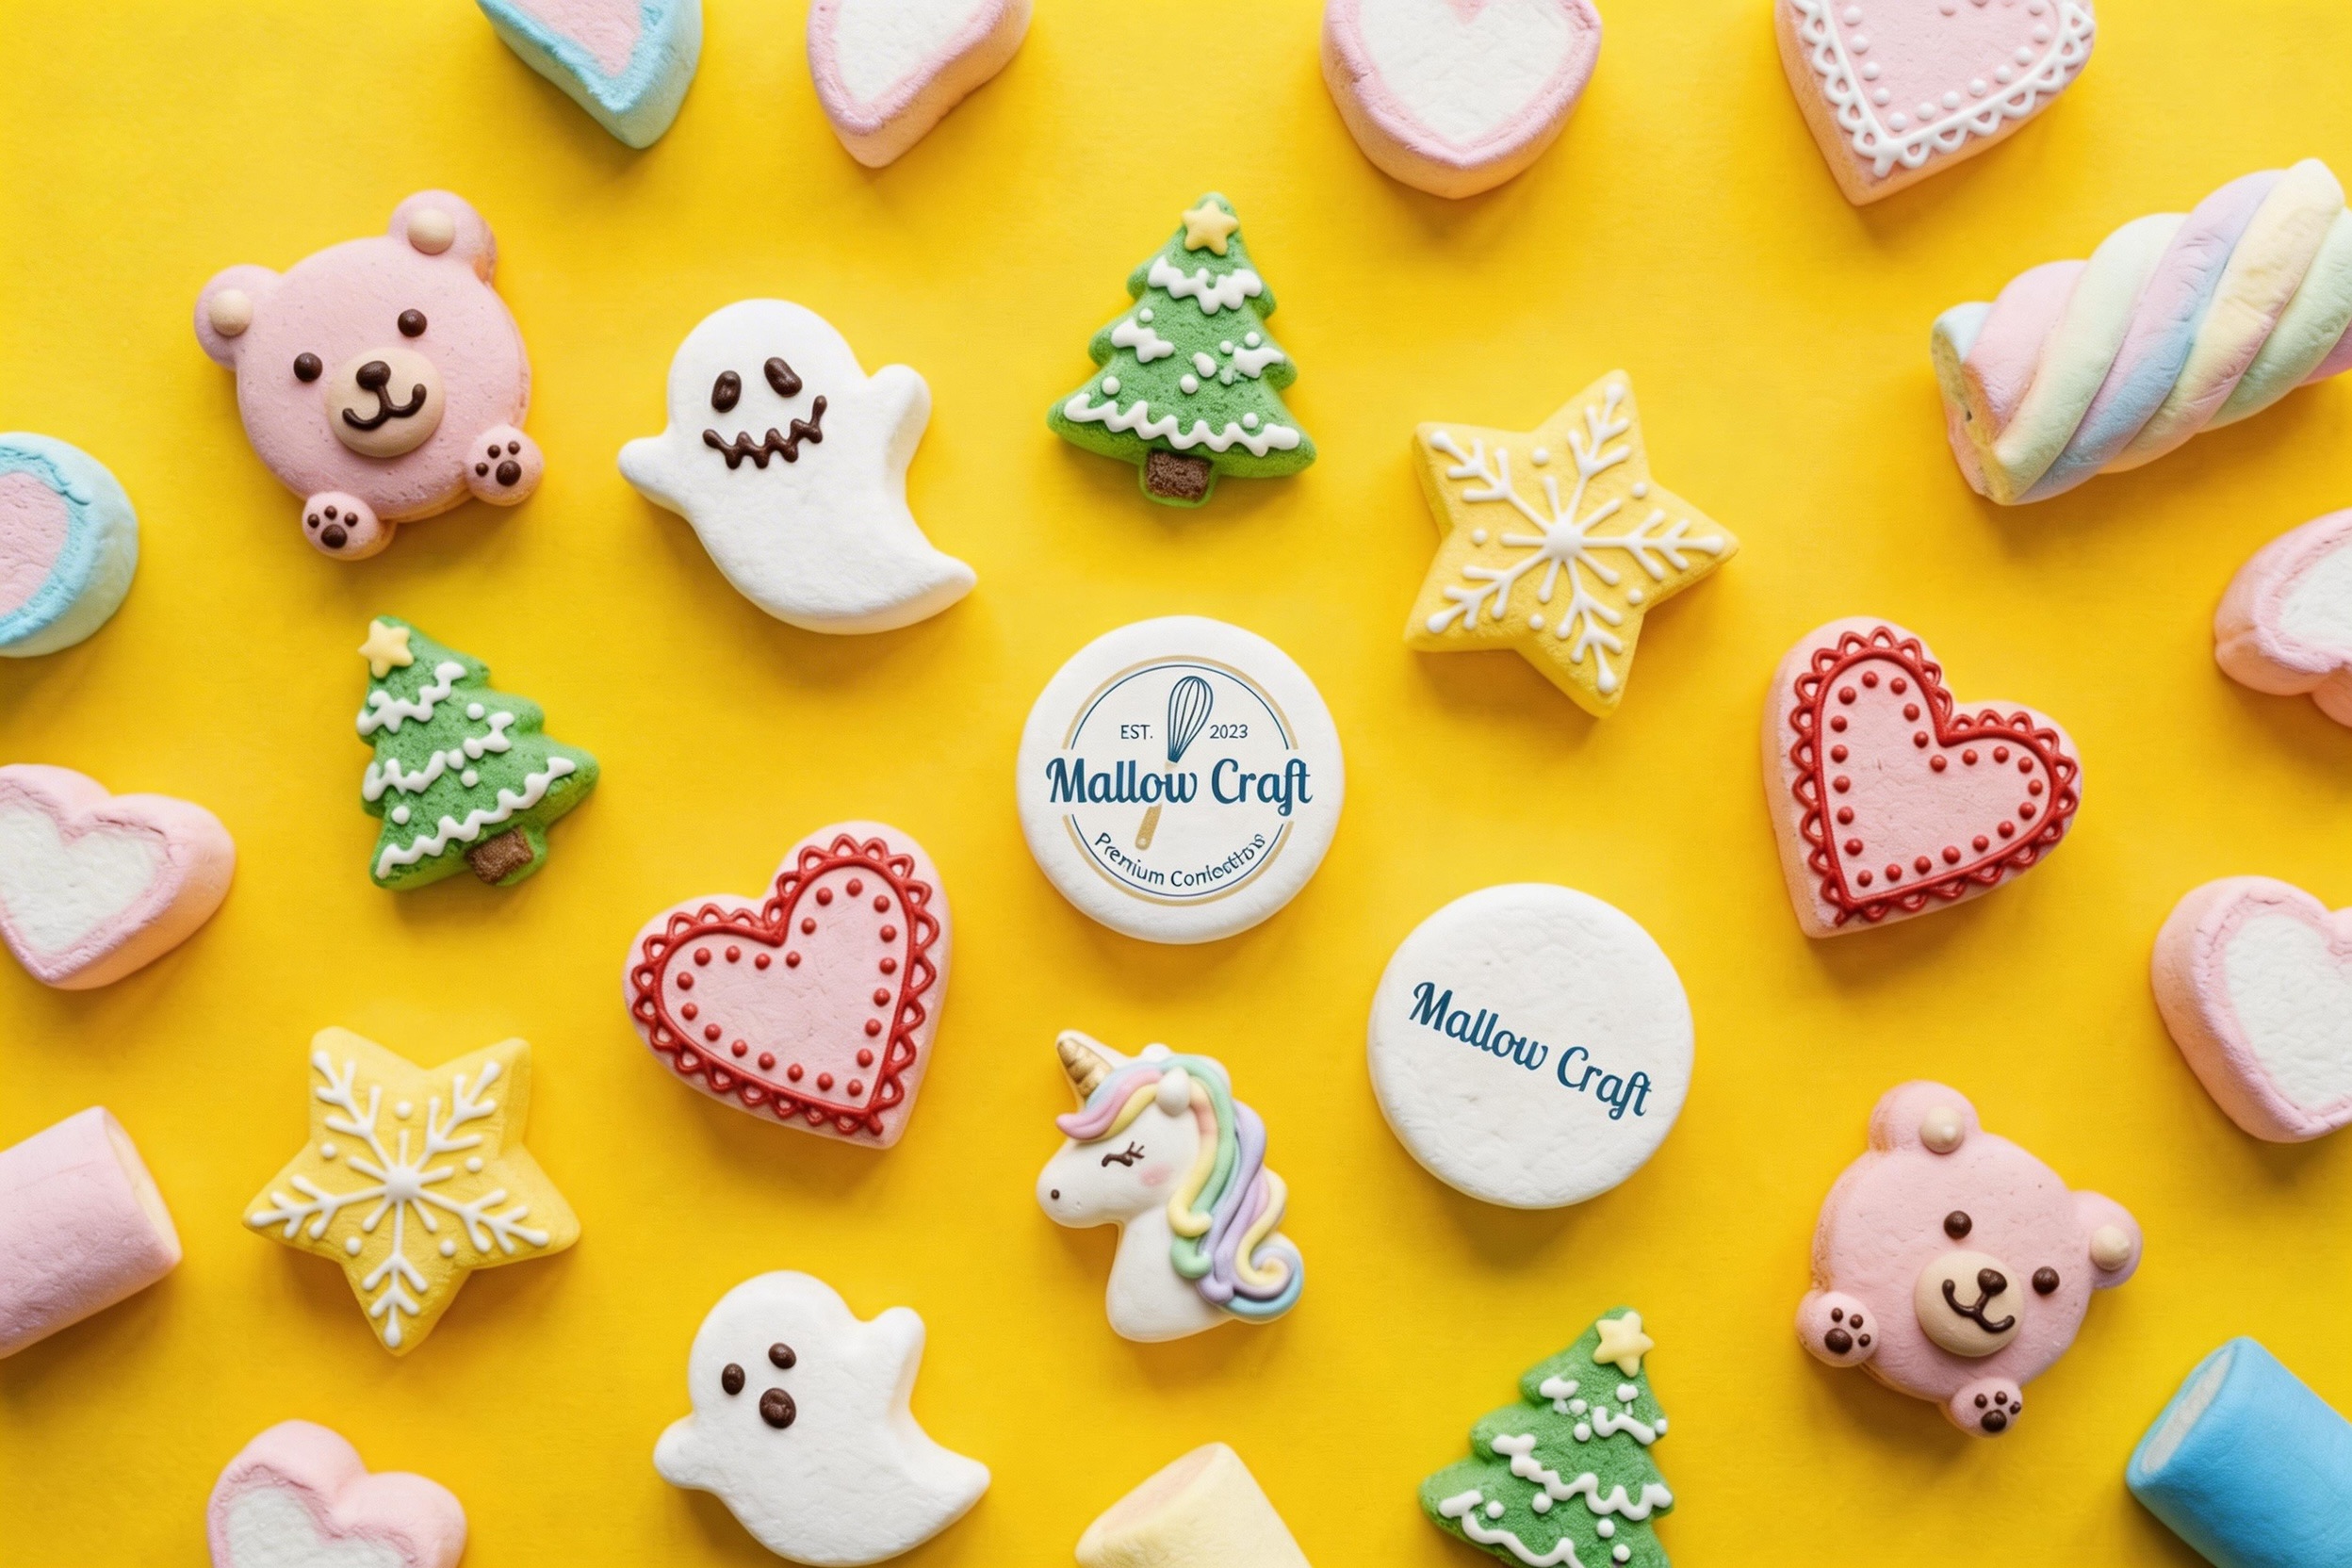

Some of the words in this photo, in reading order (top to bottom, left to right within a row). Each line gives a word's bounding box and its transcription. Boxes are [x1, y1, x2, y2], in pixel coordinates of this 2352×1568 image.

[1120, 724, 1153, 740] EST.
[1209, 725, 1249, 740] 2023
[1045, 757, 1198, 804] Mallow
[1211, 758, 1314, 817] Craft
[1094, 832, 1165, 885] Premium
[1409, 981, 1549, 1071] Mallow
[1557, 1046, 1652, 1120] Craft
